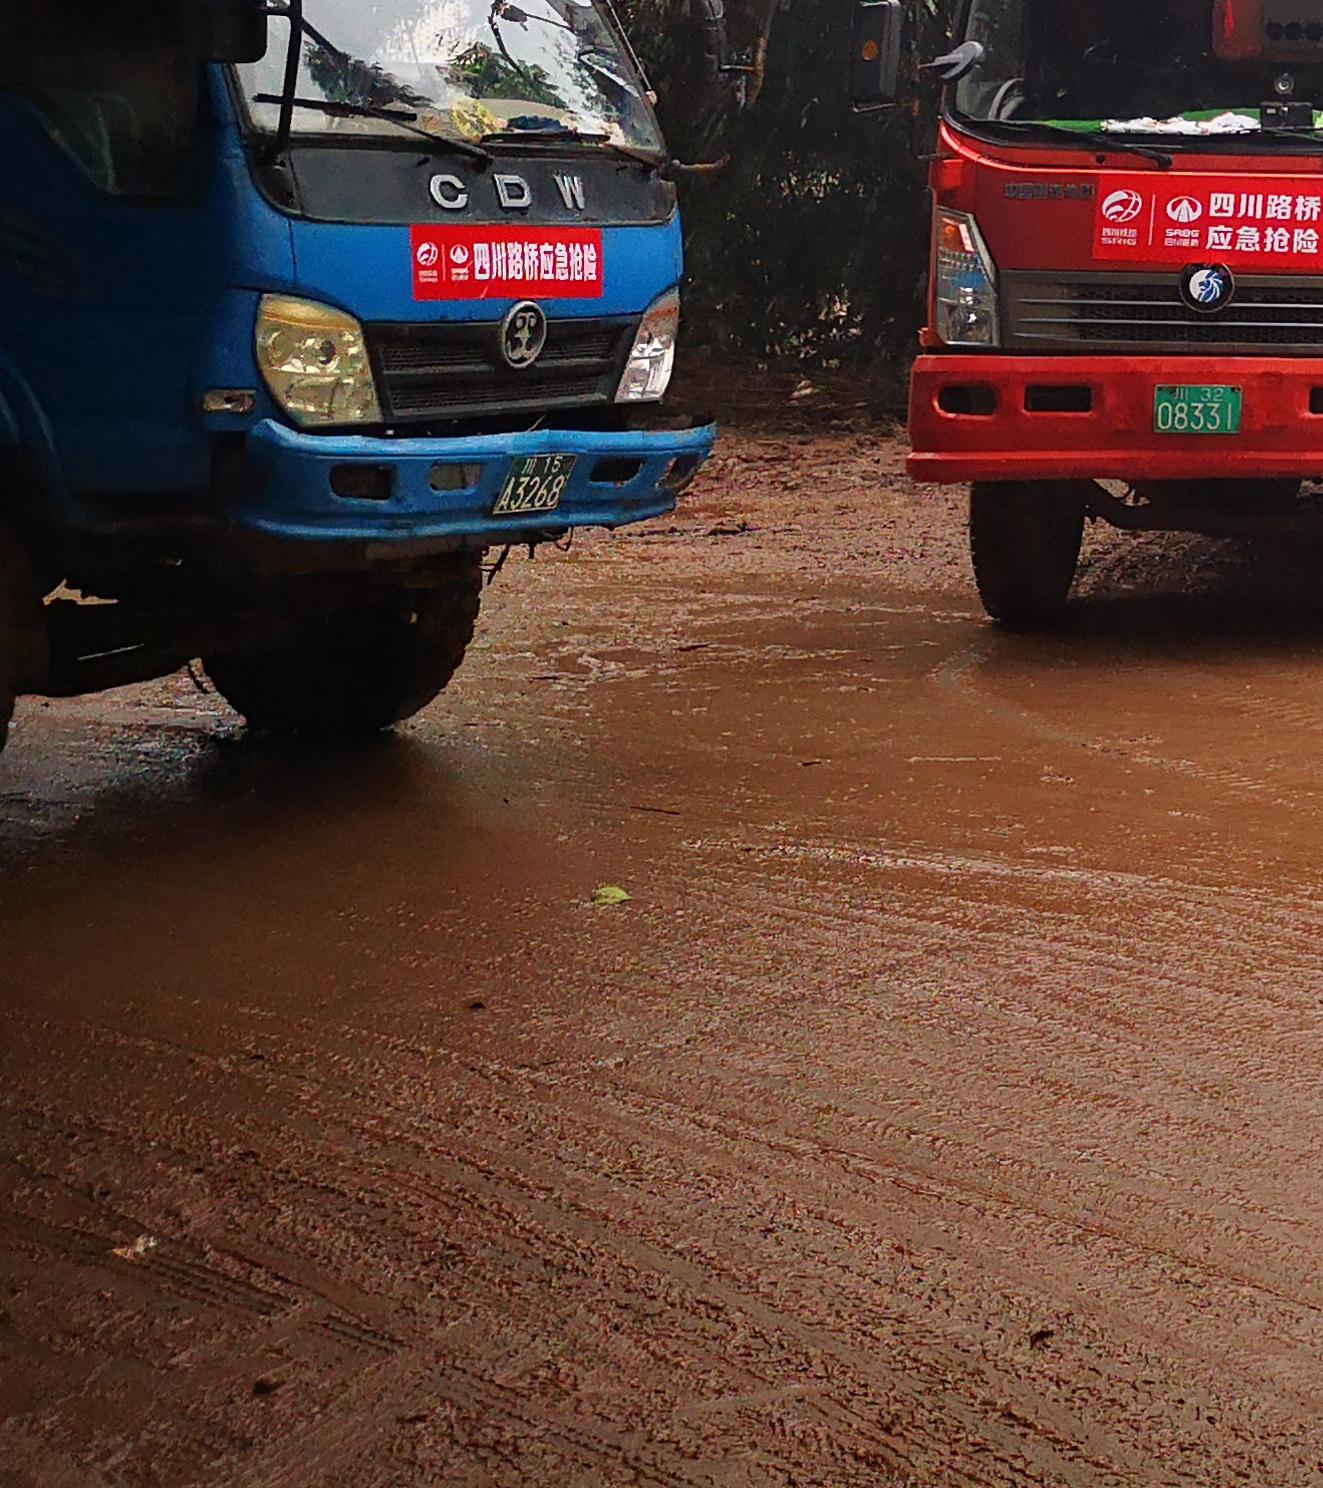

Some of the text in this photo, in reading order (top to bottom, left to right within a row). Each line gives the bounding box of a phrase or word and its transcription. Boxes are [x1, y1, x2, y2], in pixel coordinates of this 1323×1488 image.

[429, 172, 586, 210] CDW
[1209, 192, 1321, 221] 四川路桥
[1206, 225, 1319, 254] 应急抢险
[473, 242, 597, 282] 四川路桥应急抢险
[1200, 387, 1224, 402] 32
[1157, 402, 1233, 430] 08331
[543, 455, 564, 474] 15
[496, 474, 567, 511] A3268
